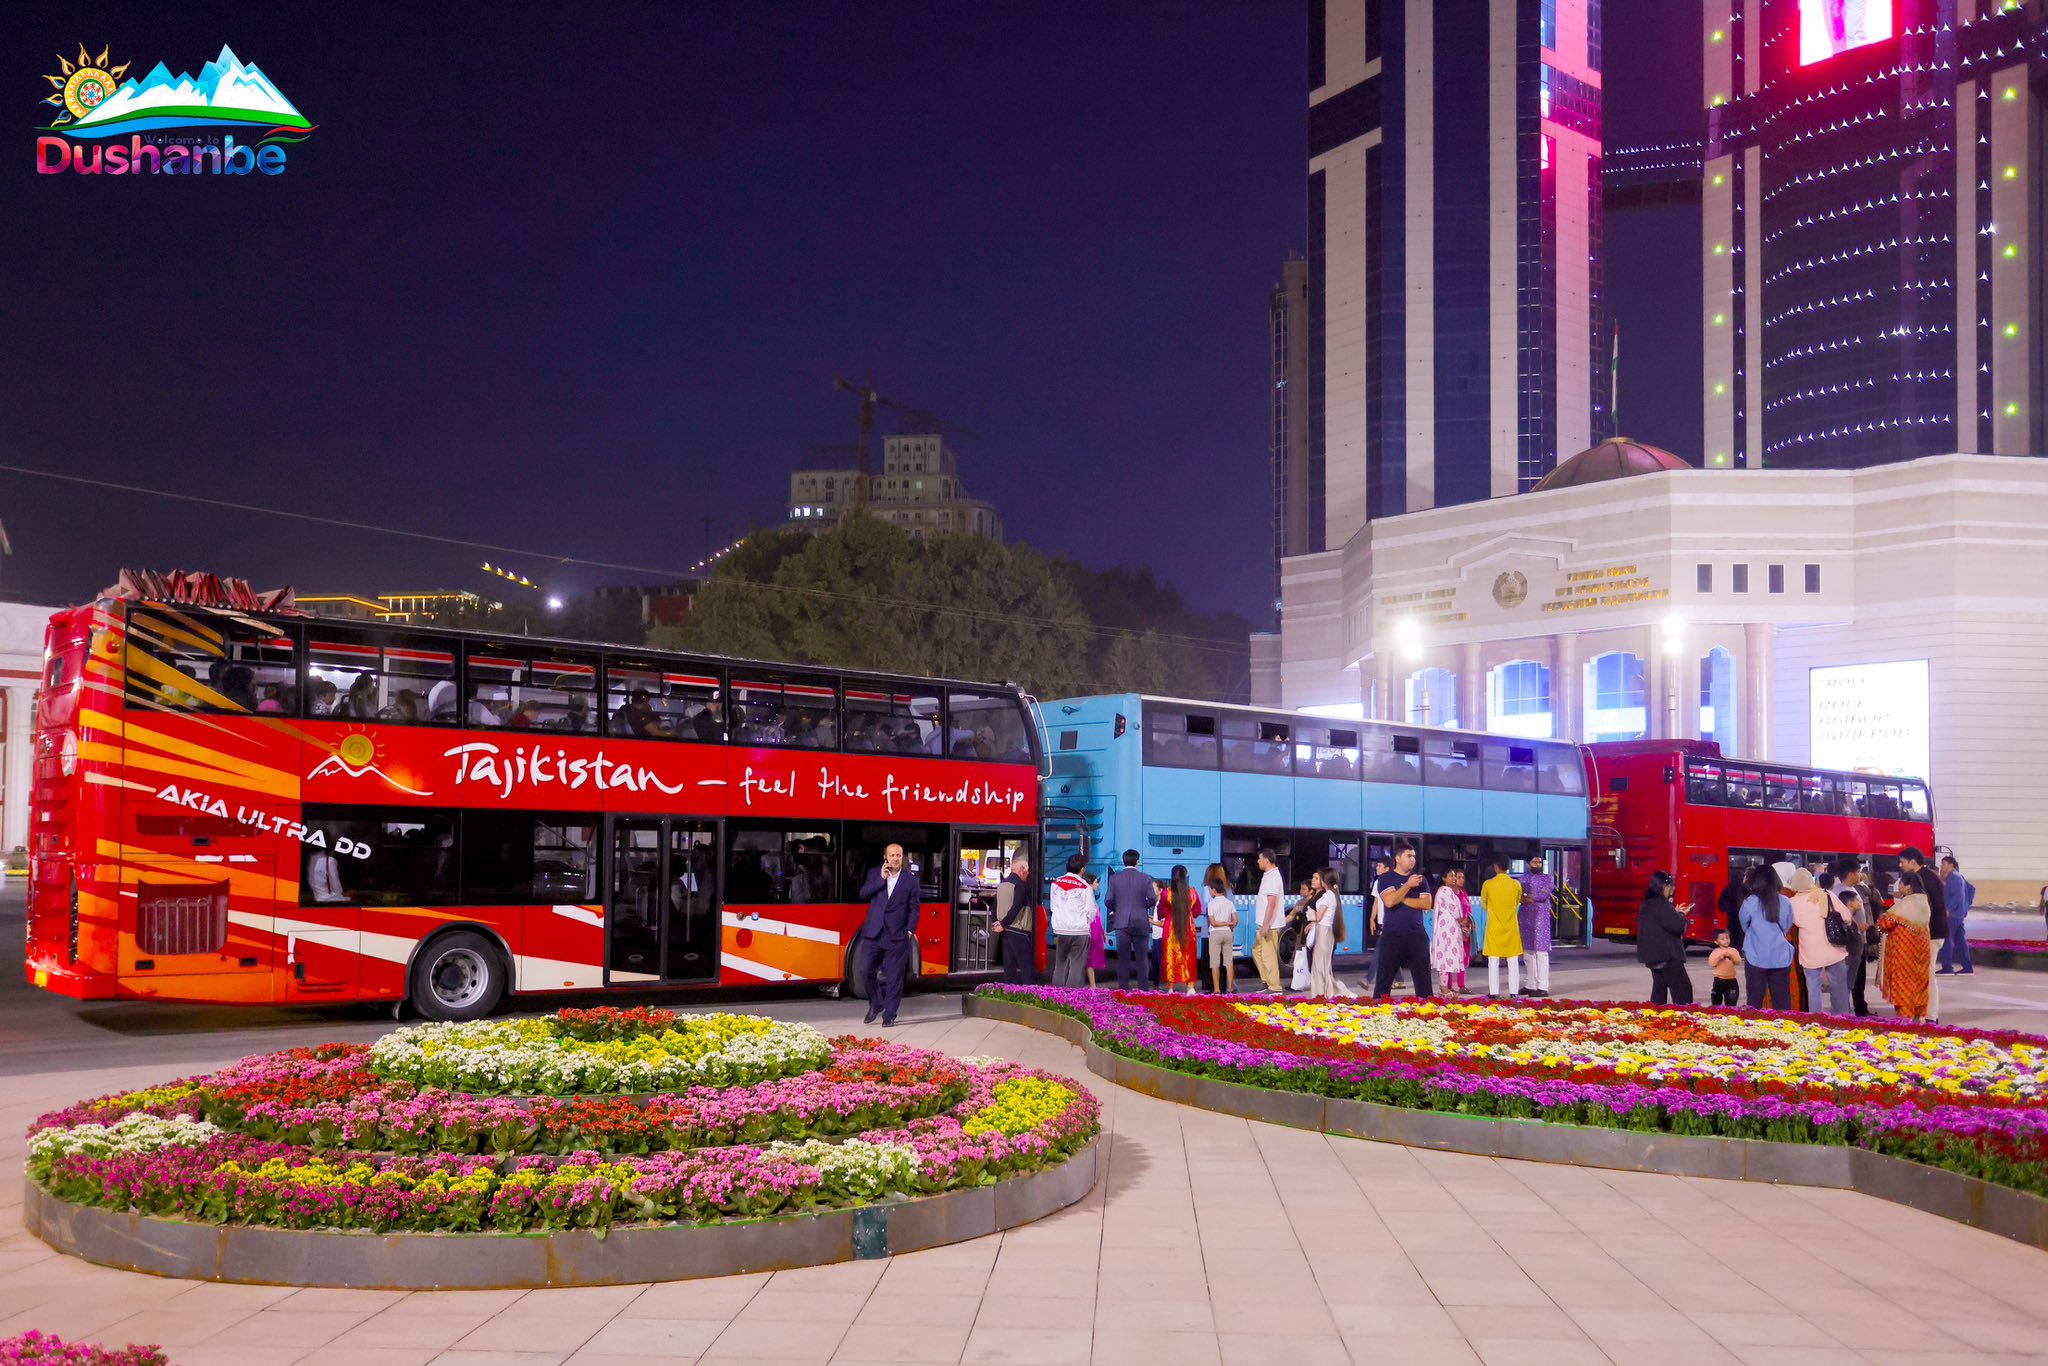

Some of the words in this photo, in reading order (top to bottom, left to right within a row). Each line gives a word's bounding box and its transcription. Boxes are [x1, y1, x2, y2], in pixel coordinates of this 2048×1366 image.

[443, 742, 684, 799] Tajikistan
[739, 766, 796, 805] feel
[817, 766, 869, 799] the
[881, 773, 1025, 814] friendship
[156, 784, 229, 818] AKIA
[237, 805, 328, 848] ULTRA
[334, 837, 372, 860] DD
